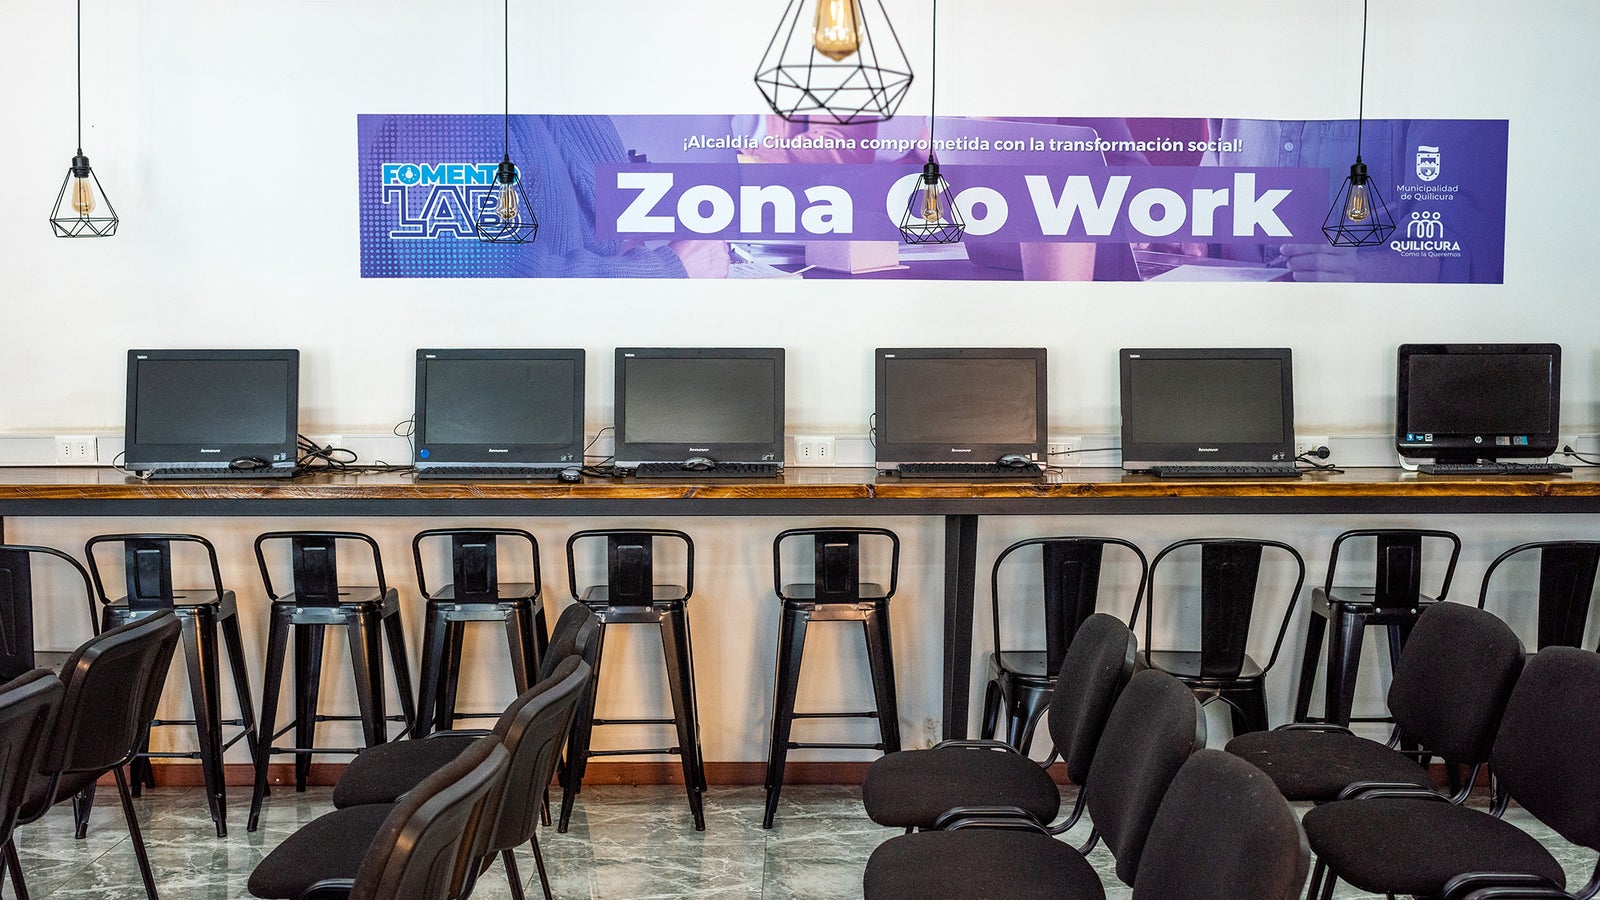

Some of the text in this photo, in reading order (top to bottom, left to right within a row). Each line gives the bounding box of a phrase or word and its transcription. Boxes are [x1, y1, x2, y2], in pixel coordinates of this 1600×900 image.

[683, 134, 1244, 152] ¡Alcaldía Ciudadana comprometida con la transformación social!
[1396, 184, 1459, 193] Municipalidad
[615, 172, 1294, 237] Zona Co Work
[1414, 193, 1454, 201] Quilicura
[382, 184, 522, 239] LAB
[1390, 240, 1461, 252] QUILICURA
